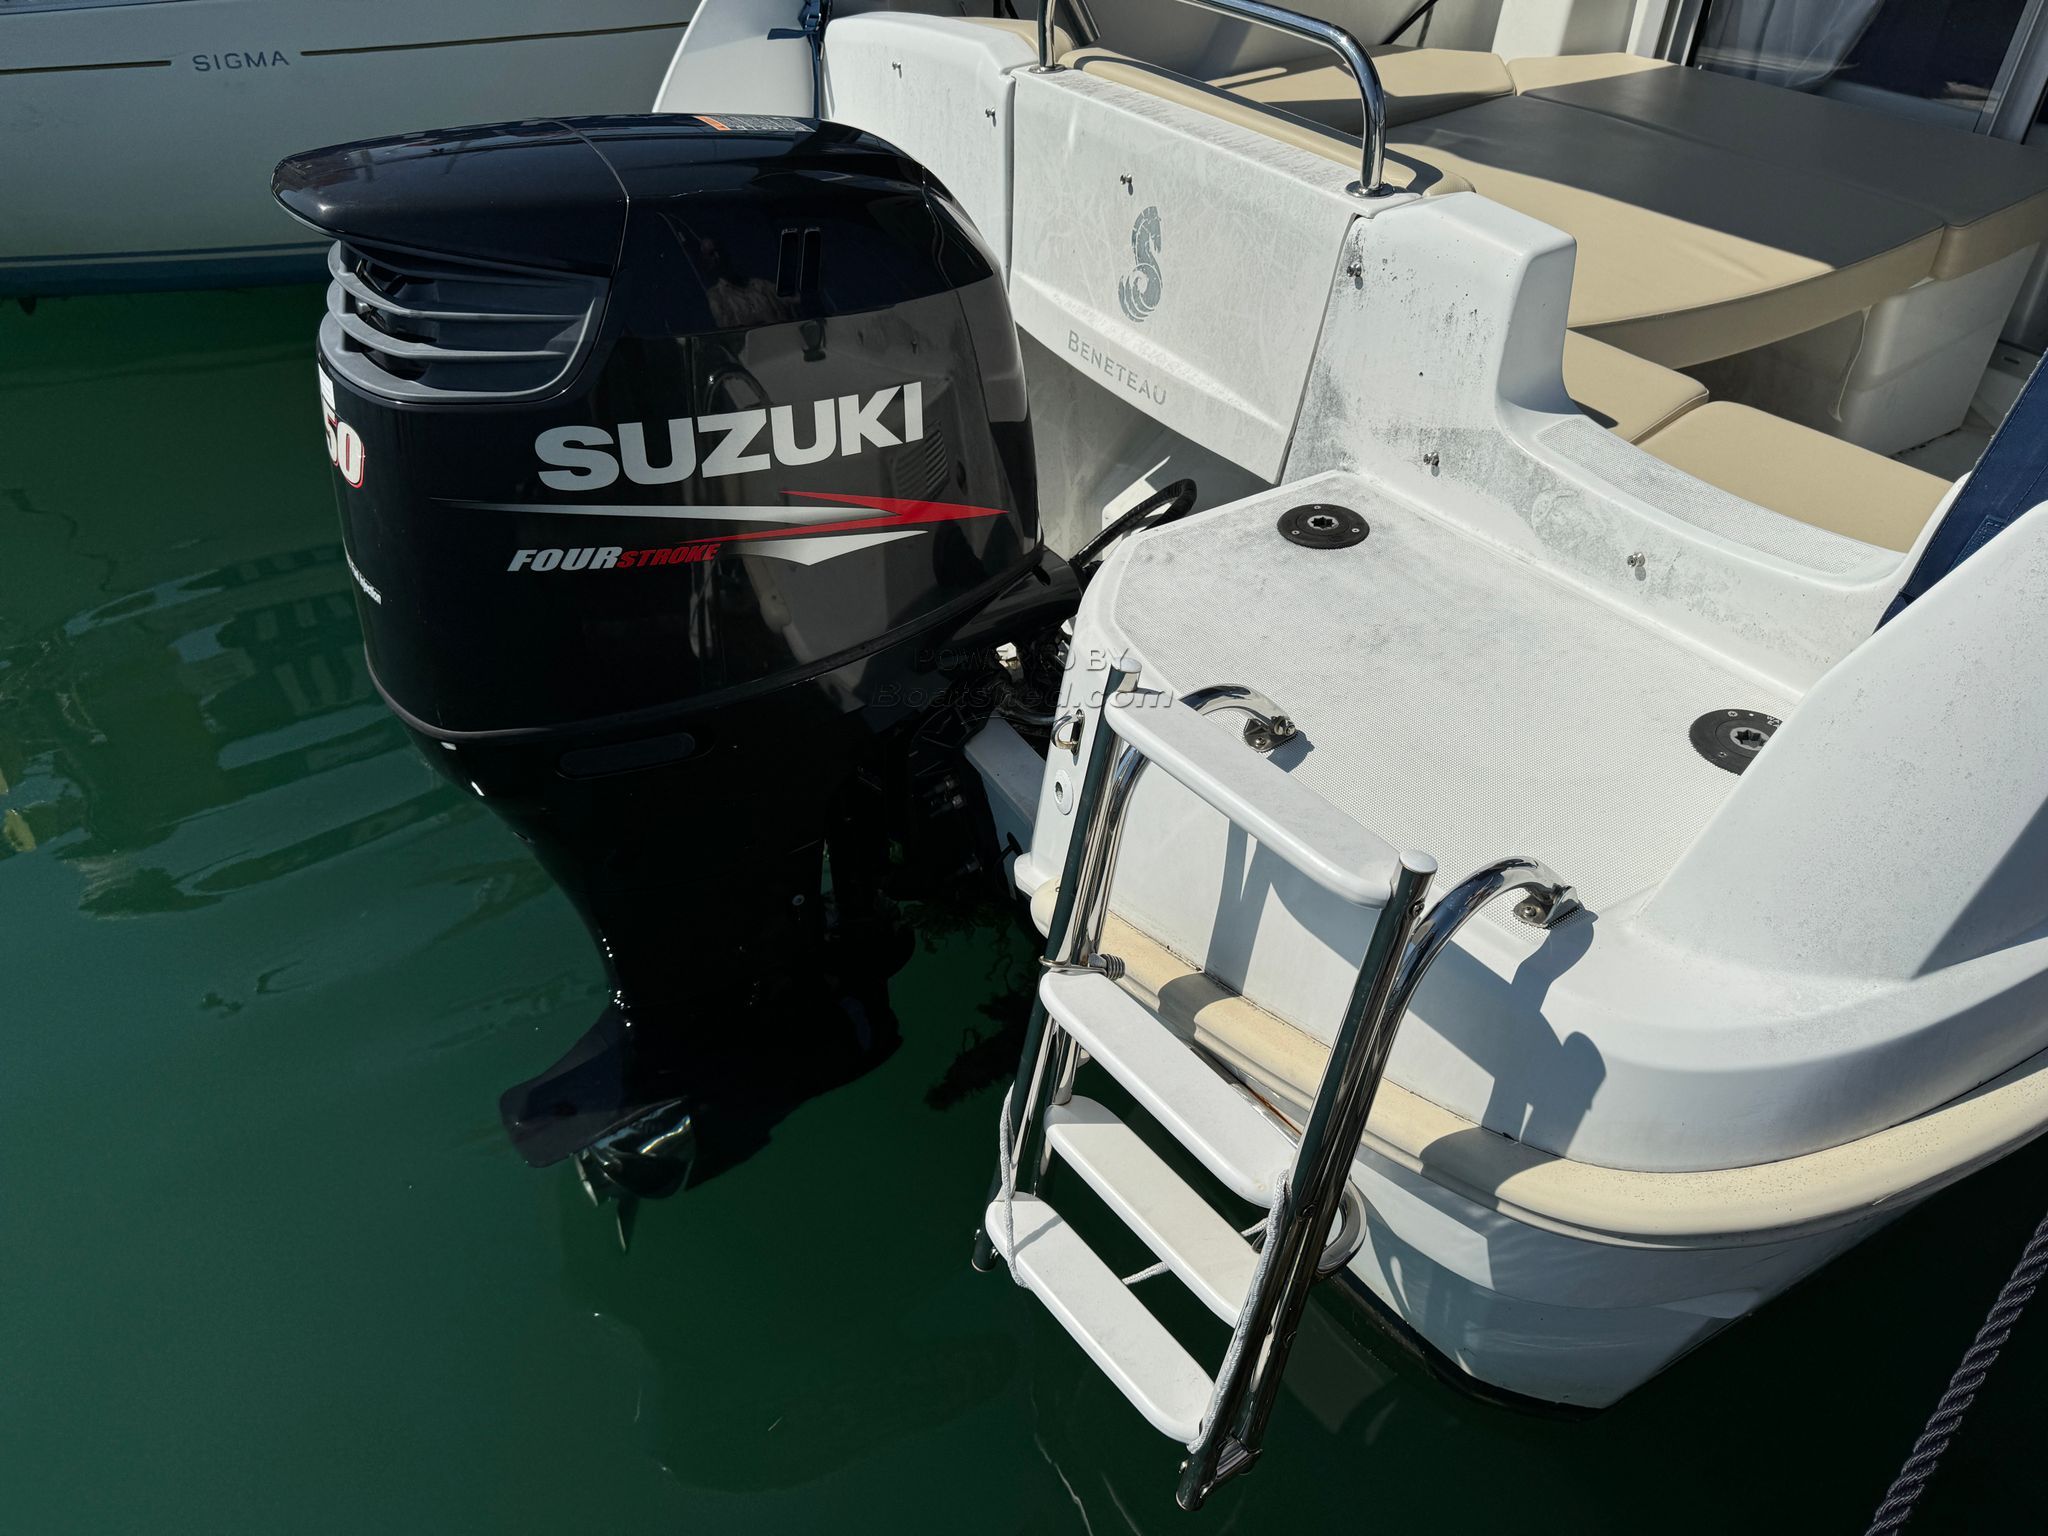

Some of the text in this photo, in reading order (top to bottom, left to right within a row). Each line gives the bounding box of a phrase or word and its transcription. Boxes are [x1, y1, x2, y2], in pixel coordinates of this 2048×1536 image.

[192, 51, 290, 72] SIGMA
[1067, 330, 1167, 405] BENETEAU
[534, 380, 924, 492] SUZUKI
